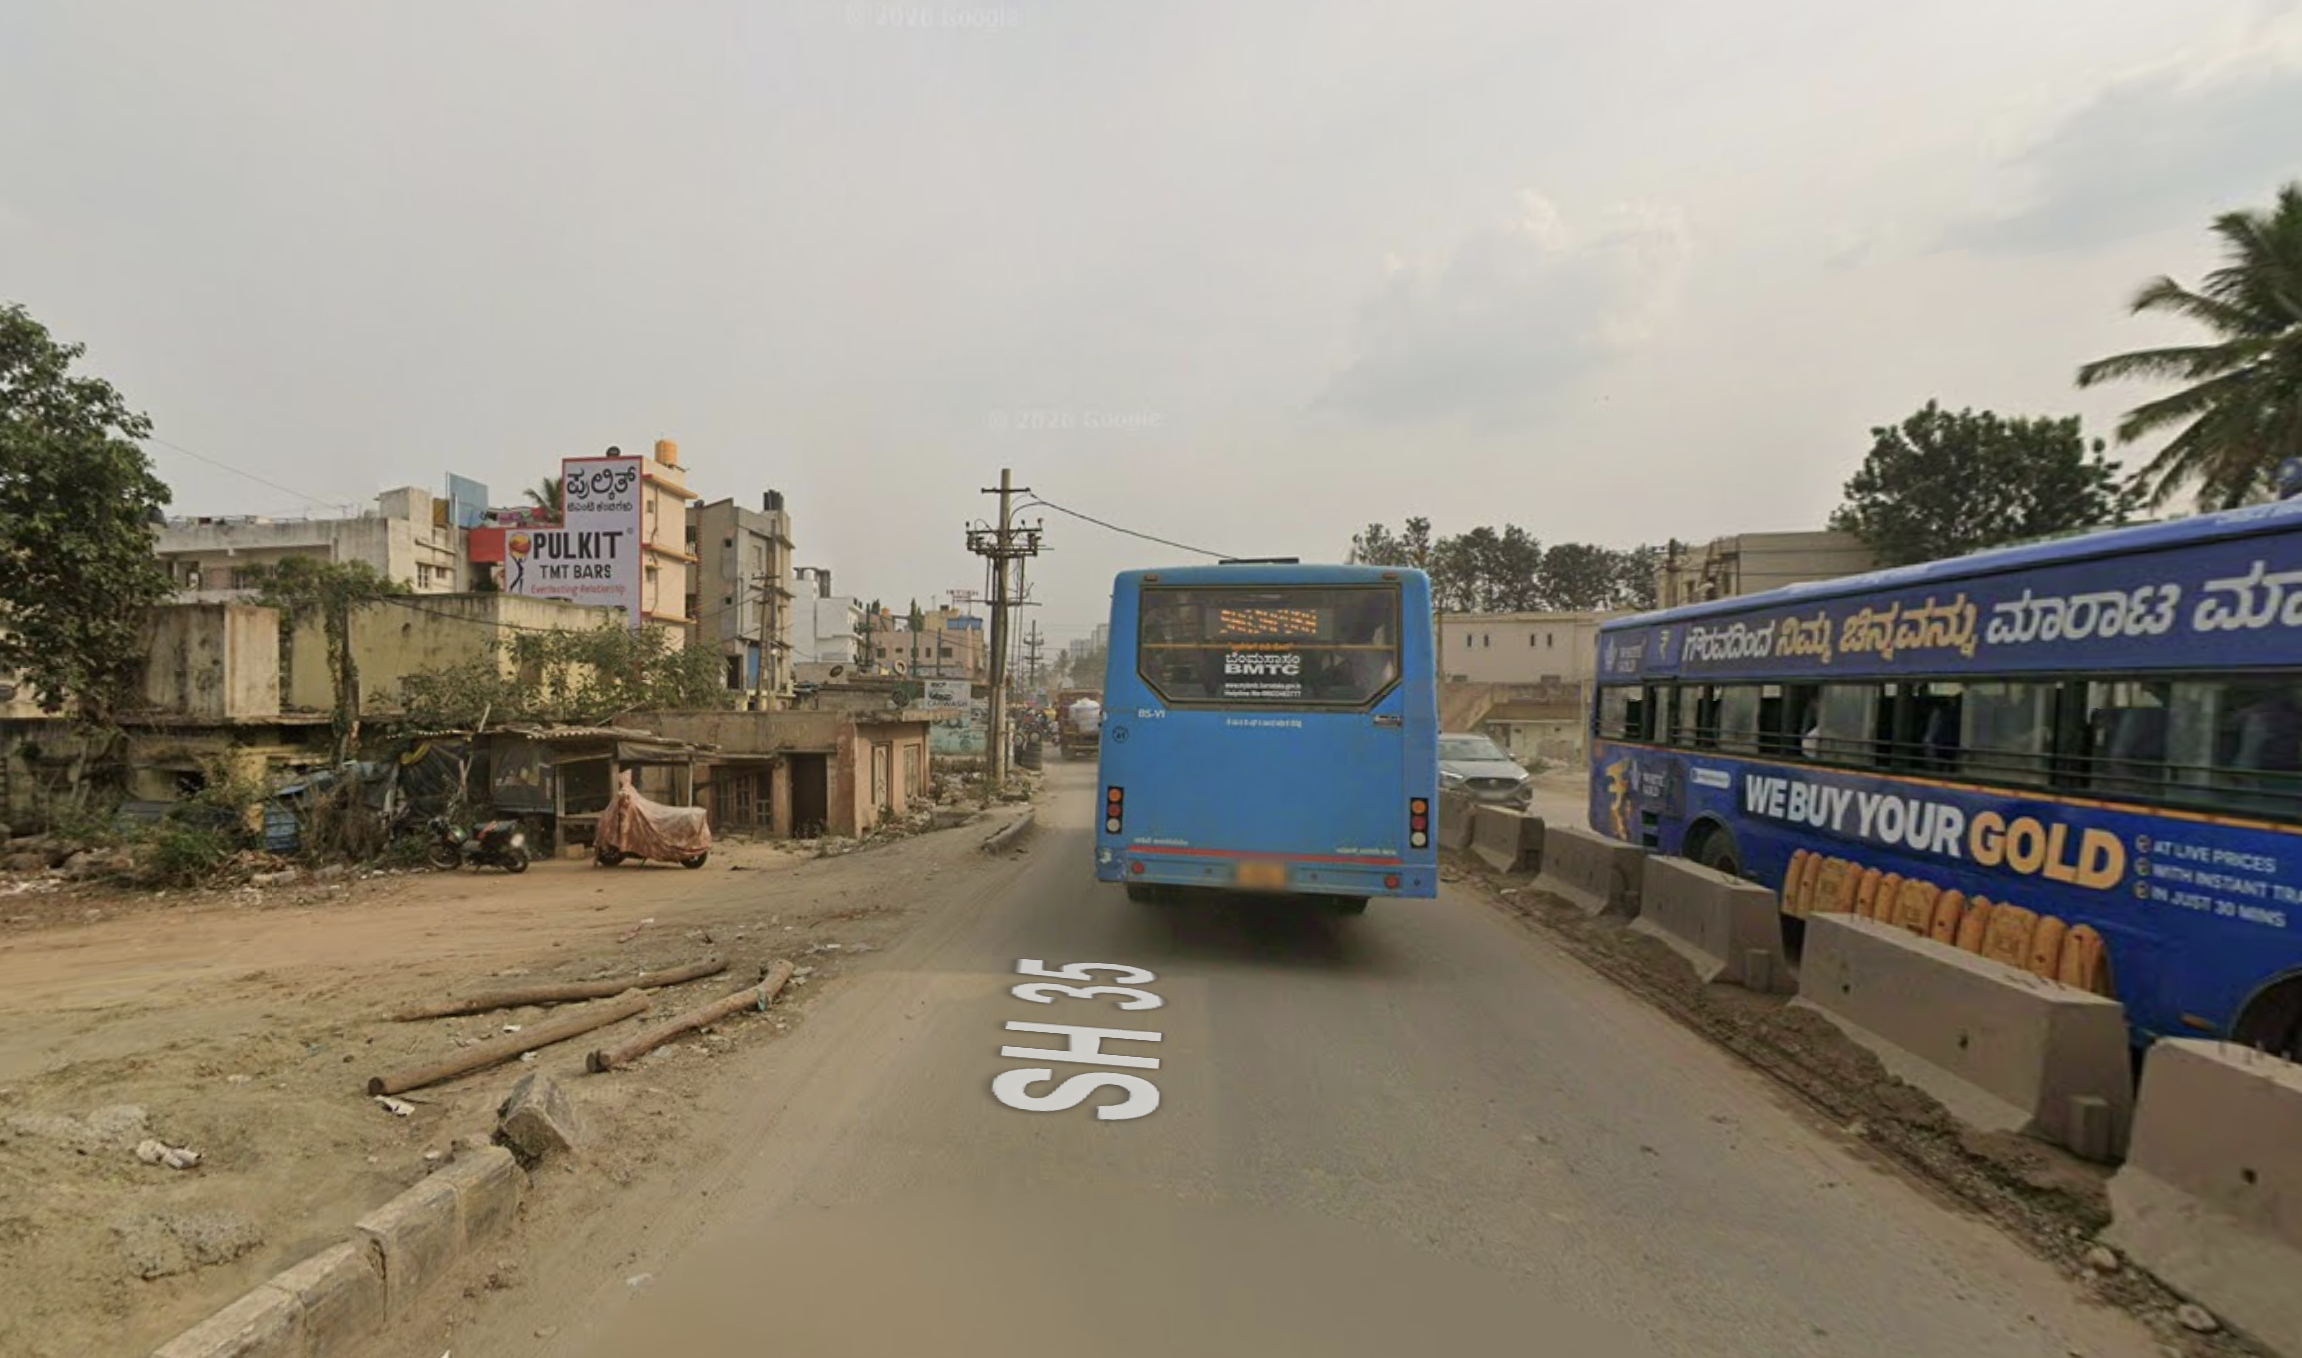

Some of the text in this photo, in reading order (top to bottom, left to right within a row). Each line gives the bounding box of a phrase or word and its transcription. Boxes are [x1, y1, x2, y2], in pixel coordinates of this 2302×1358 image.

[533, 531, 624, 560] PULKIT
[540, 564, 612, 579] TMT BARS
[1682, 620, 1775, 662] ಗೌರವದಿಂದ
[1776, 611, 1832, 664] ನಿಮ್ಮ
[1839, 593, 1978, 661] ಚಿನ್ನವನ್ನು
[1986, 583, 2182, 645] ಮಾರಾಟ
[1224, 663, 1300, 676] BMTC
[944, 700, 968, 708] WASH
[1745, 774, 2126, 890] WE BUY YOUR GOLD
[2153, 840, 2278, 874] AT LIVE PRICES
[2151, 863, 2193, 884] WITH
[2194, 871, 2268, 899] INSTANT
[2150, 885, 2287, 928] IN JUST 30 MINS
